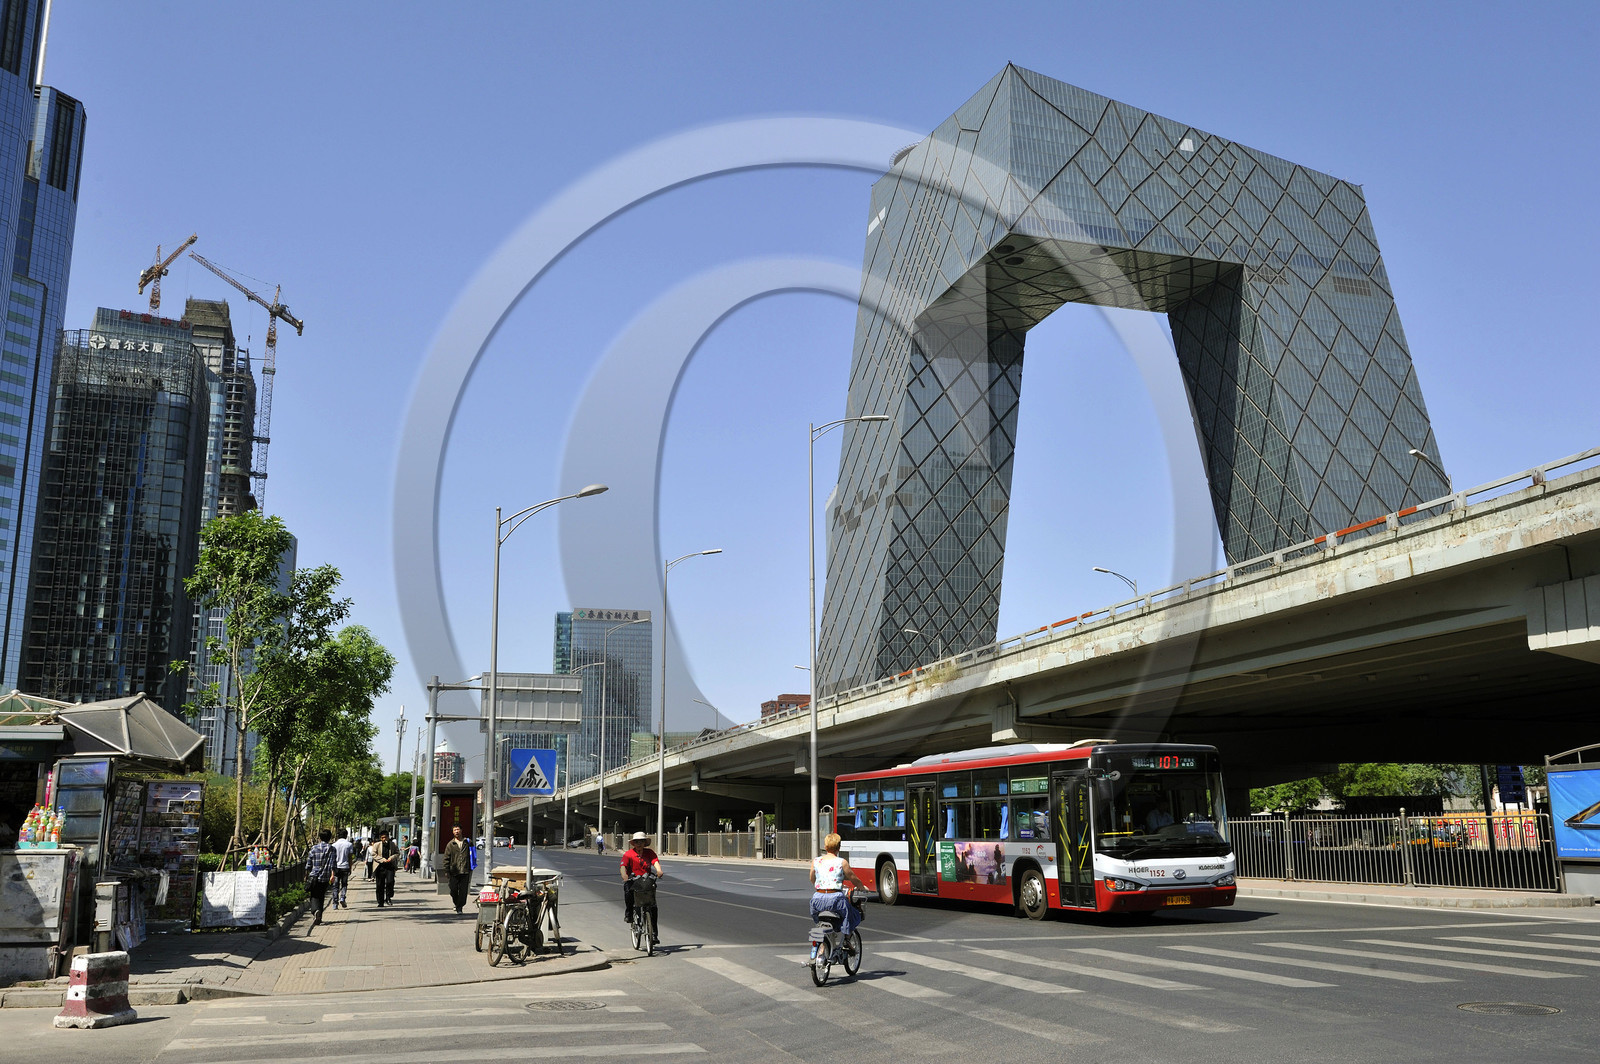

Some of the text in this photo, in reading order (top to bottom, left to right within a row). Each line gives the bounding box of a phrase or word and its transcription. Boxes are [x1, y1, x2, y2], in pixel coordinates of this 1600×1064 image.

[109, 338, 164, 354] 富尔大厦
[1159, 755, 1179, 769] 107
[1128, 866, 1150, 874] HIGER
[1149, 869, 1166, 878] 1152
